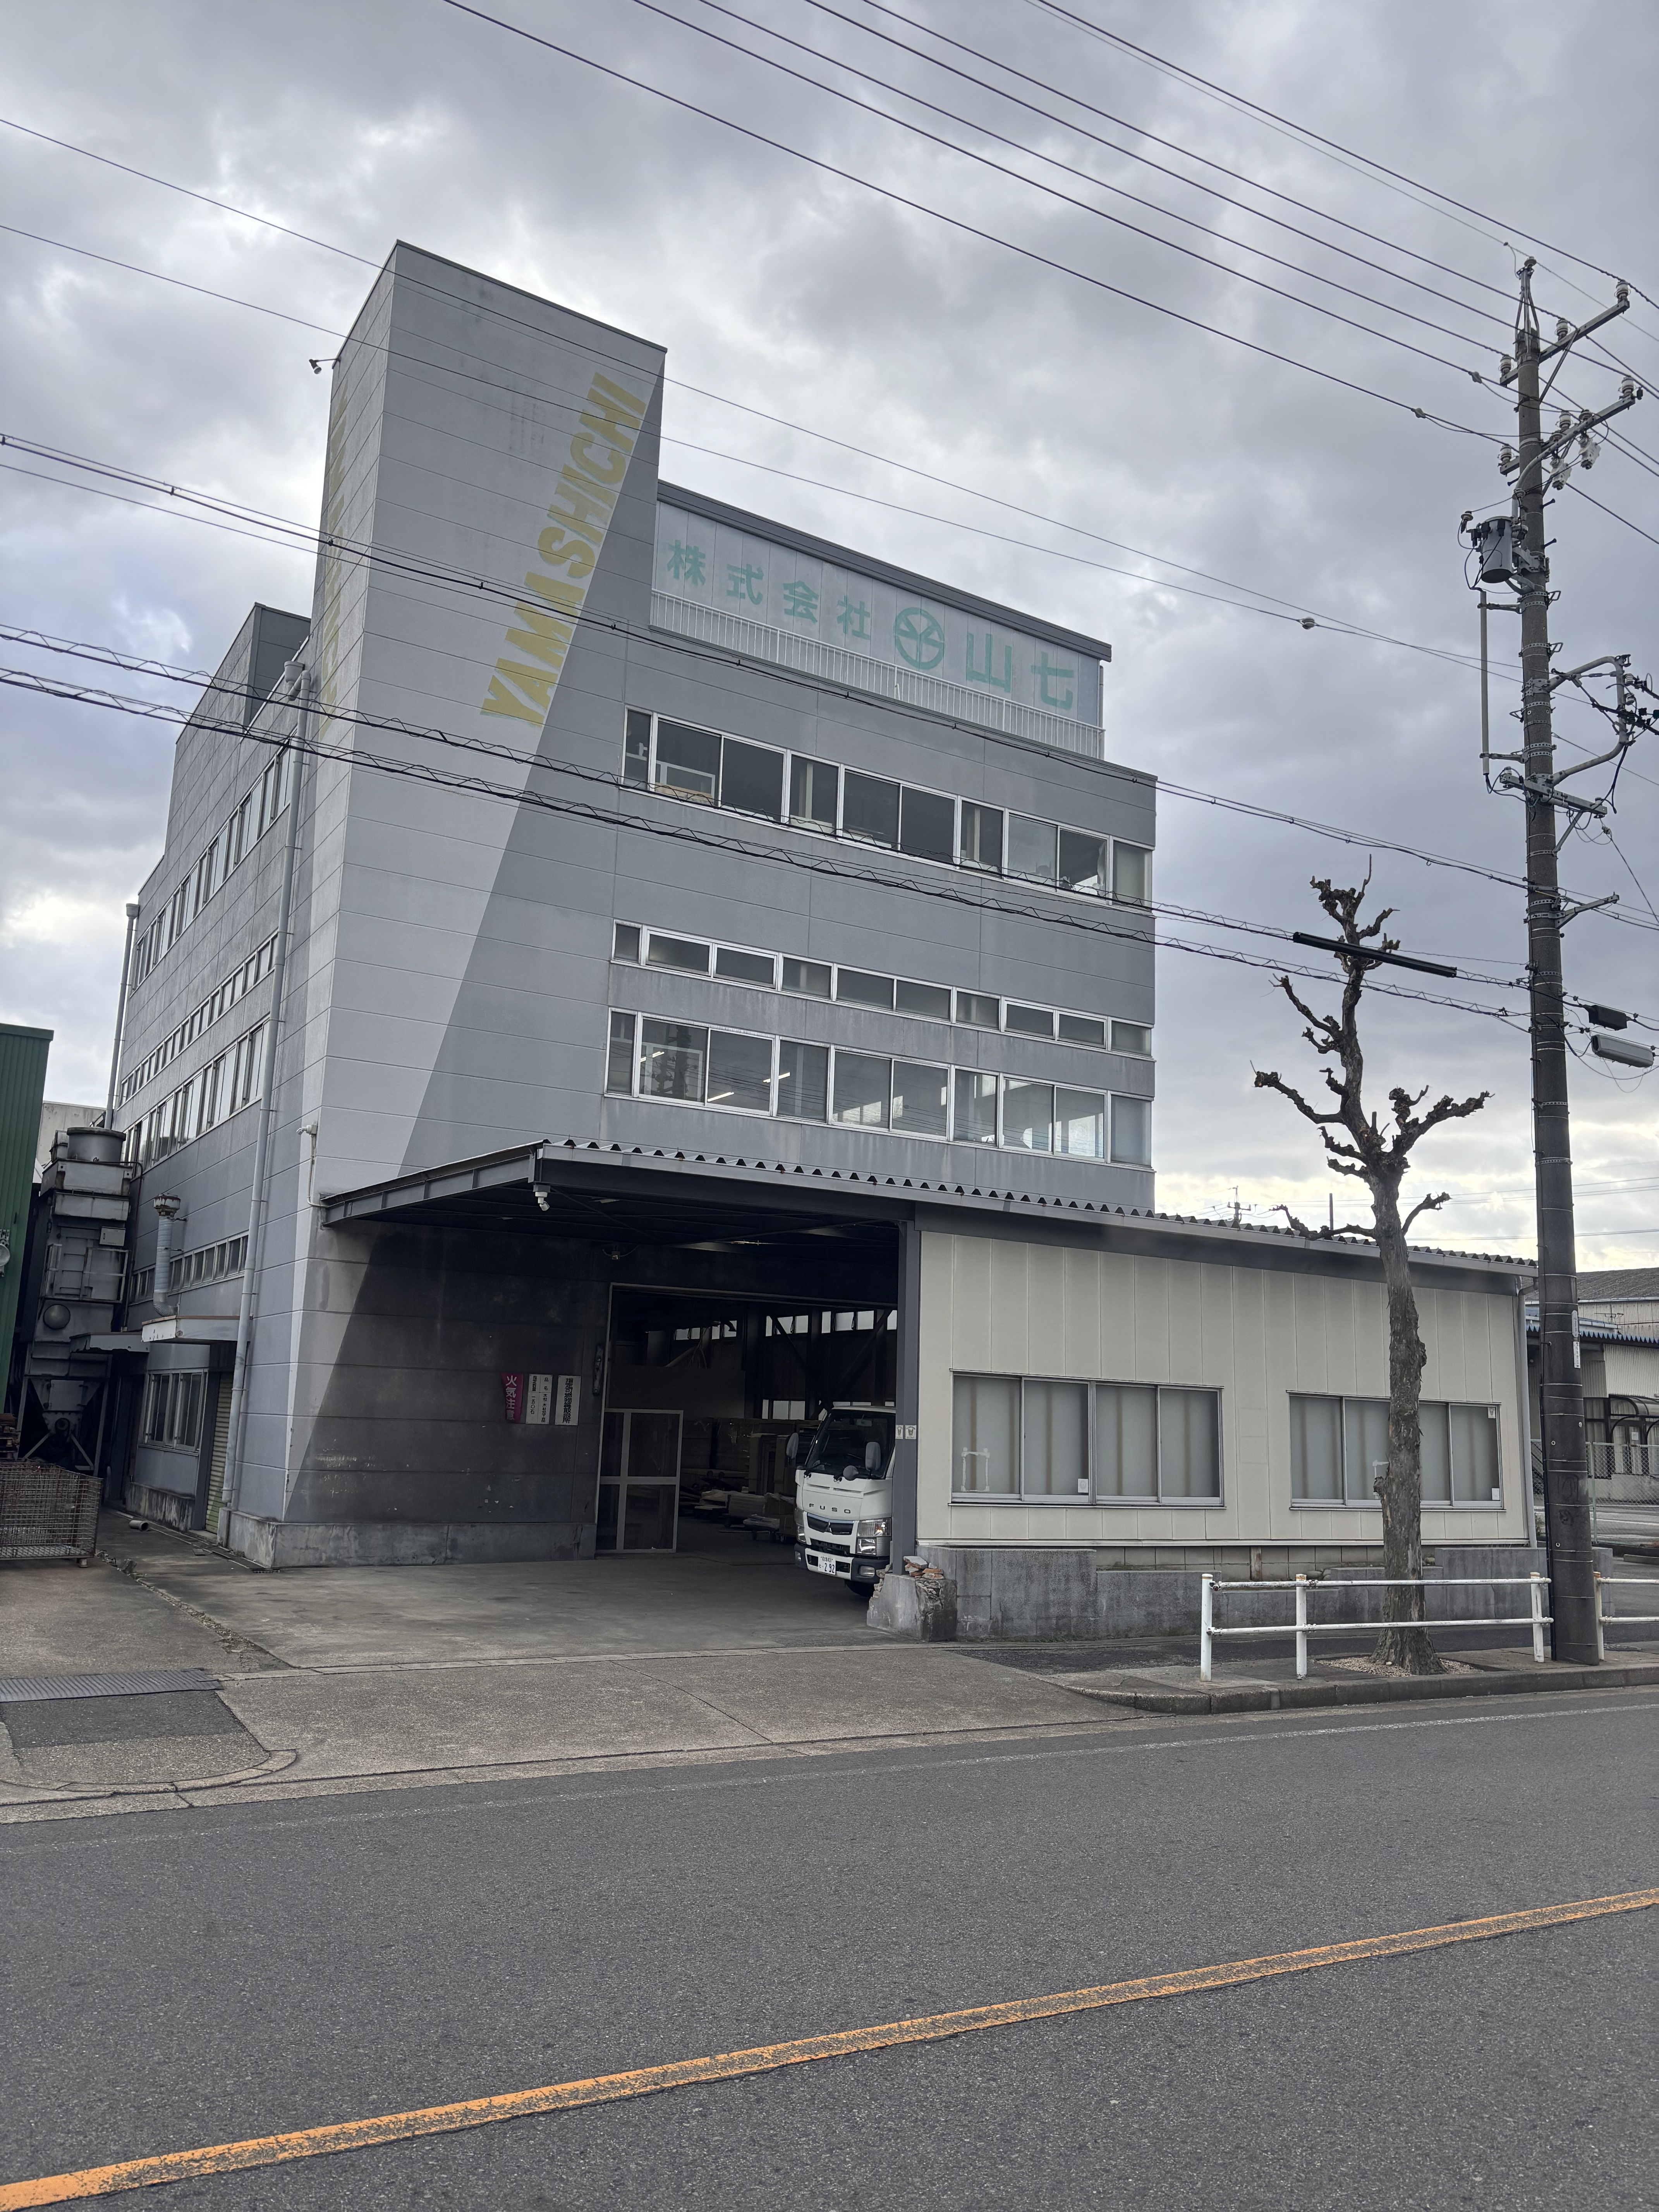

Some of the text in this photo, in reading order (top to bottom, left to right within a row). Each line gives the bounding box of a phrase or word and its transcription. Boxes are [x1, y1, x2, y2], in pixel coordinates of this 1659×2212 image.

[480, 371, 646, 727] YAMASHICHI
[667, 539, 1074, 710] 株式会社 山七
[506, 1375, 517, 1420] 火気注意
[809, 1503, 851, 1514] FUSO
